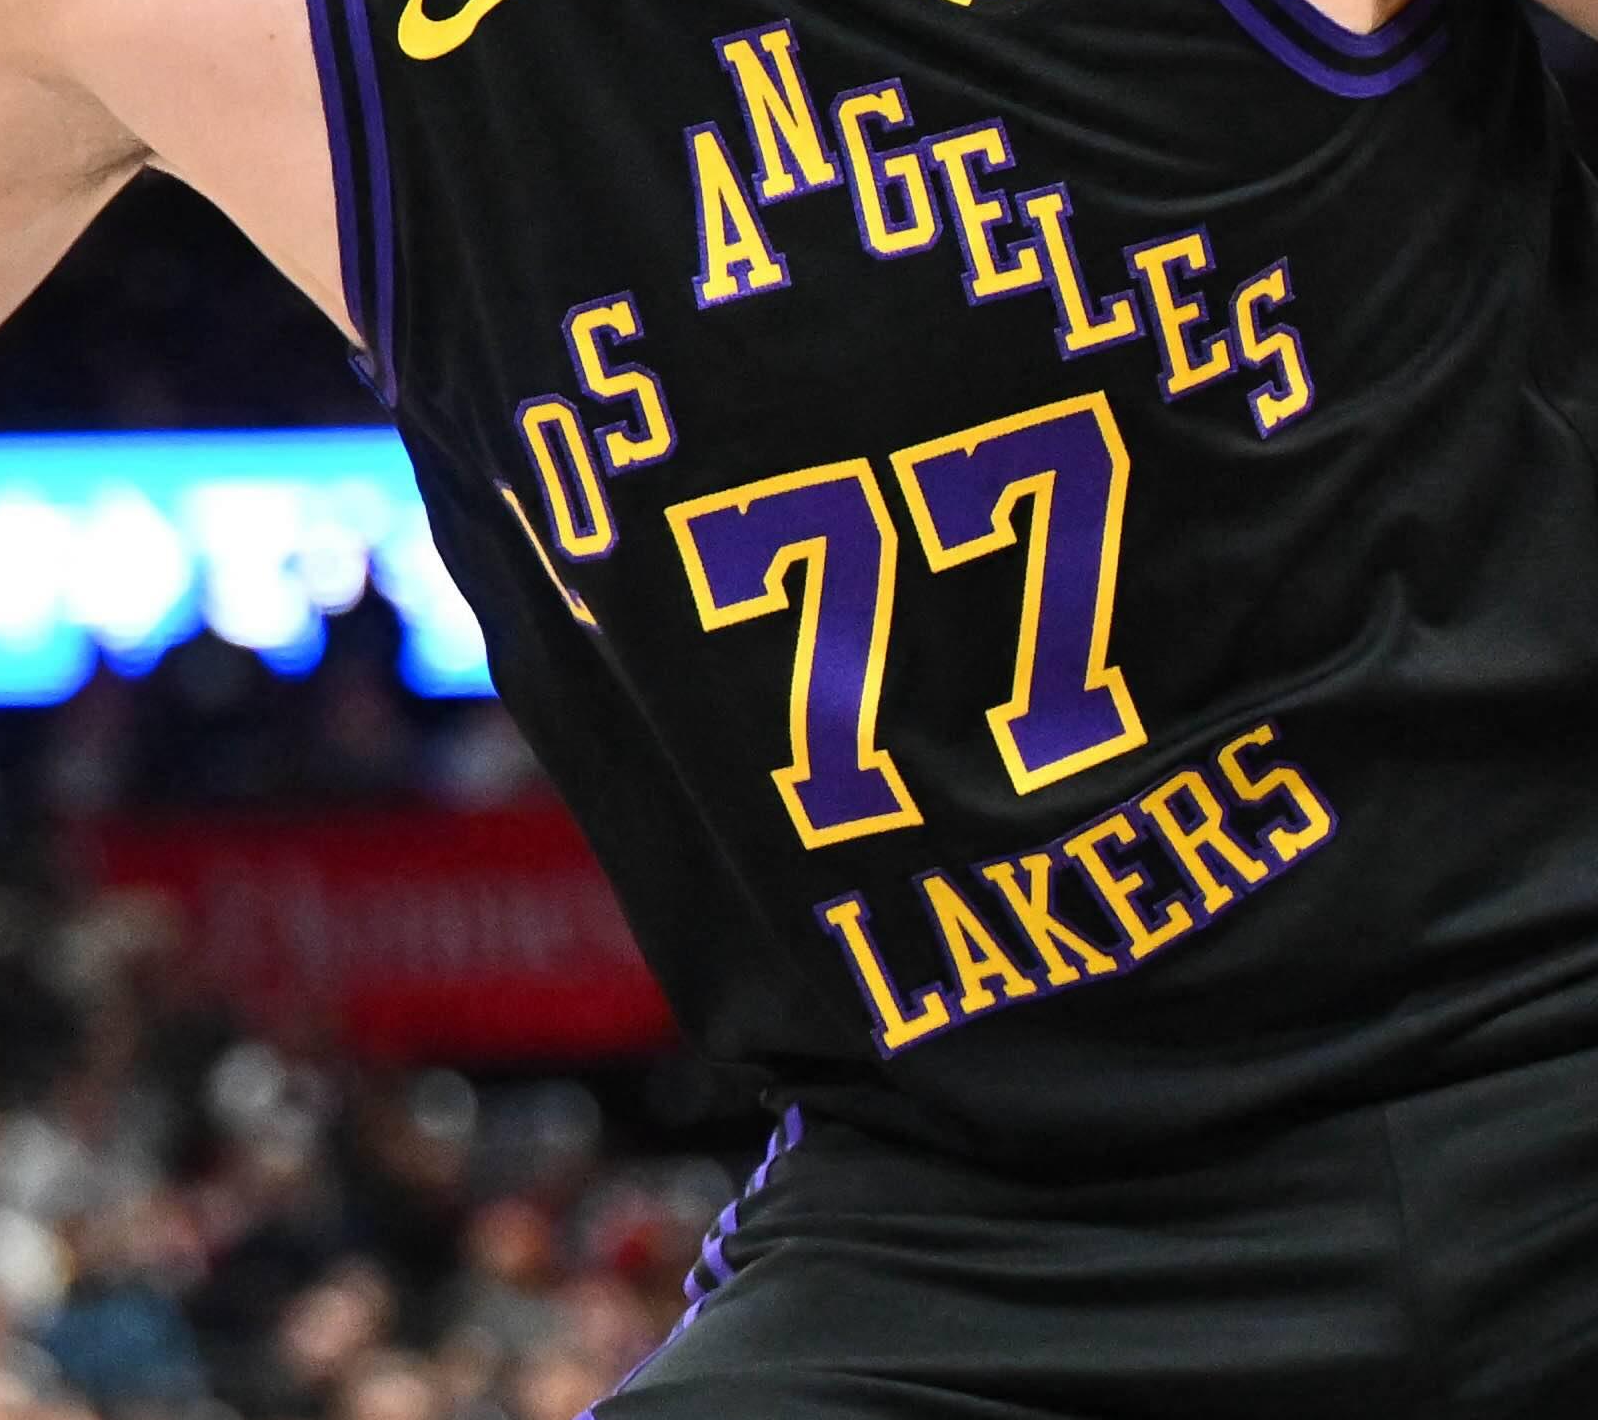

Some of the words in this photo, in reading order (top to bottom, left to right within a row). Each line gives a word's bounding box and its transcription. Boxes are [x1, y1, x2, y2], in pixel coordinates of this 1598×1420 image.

[683, 17, 1316, 439] ANGELES
[663, 389, 1148, 851] 77
[813, 718, 1340, 1060] LAKERS
